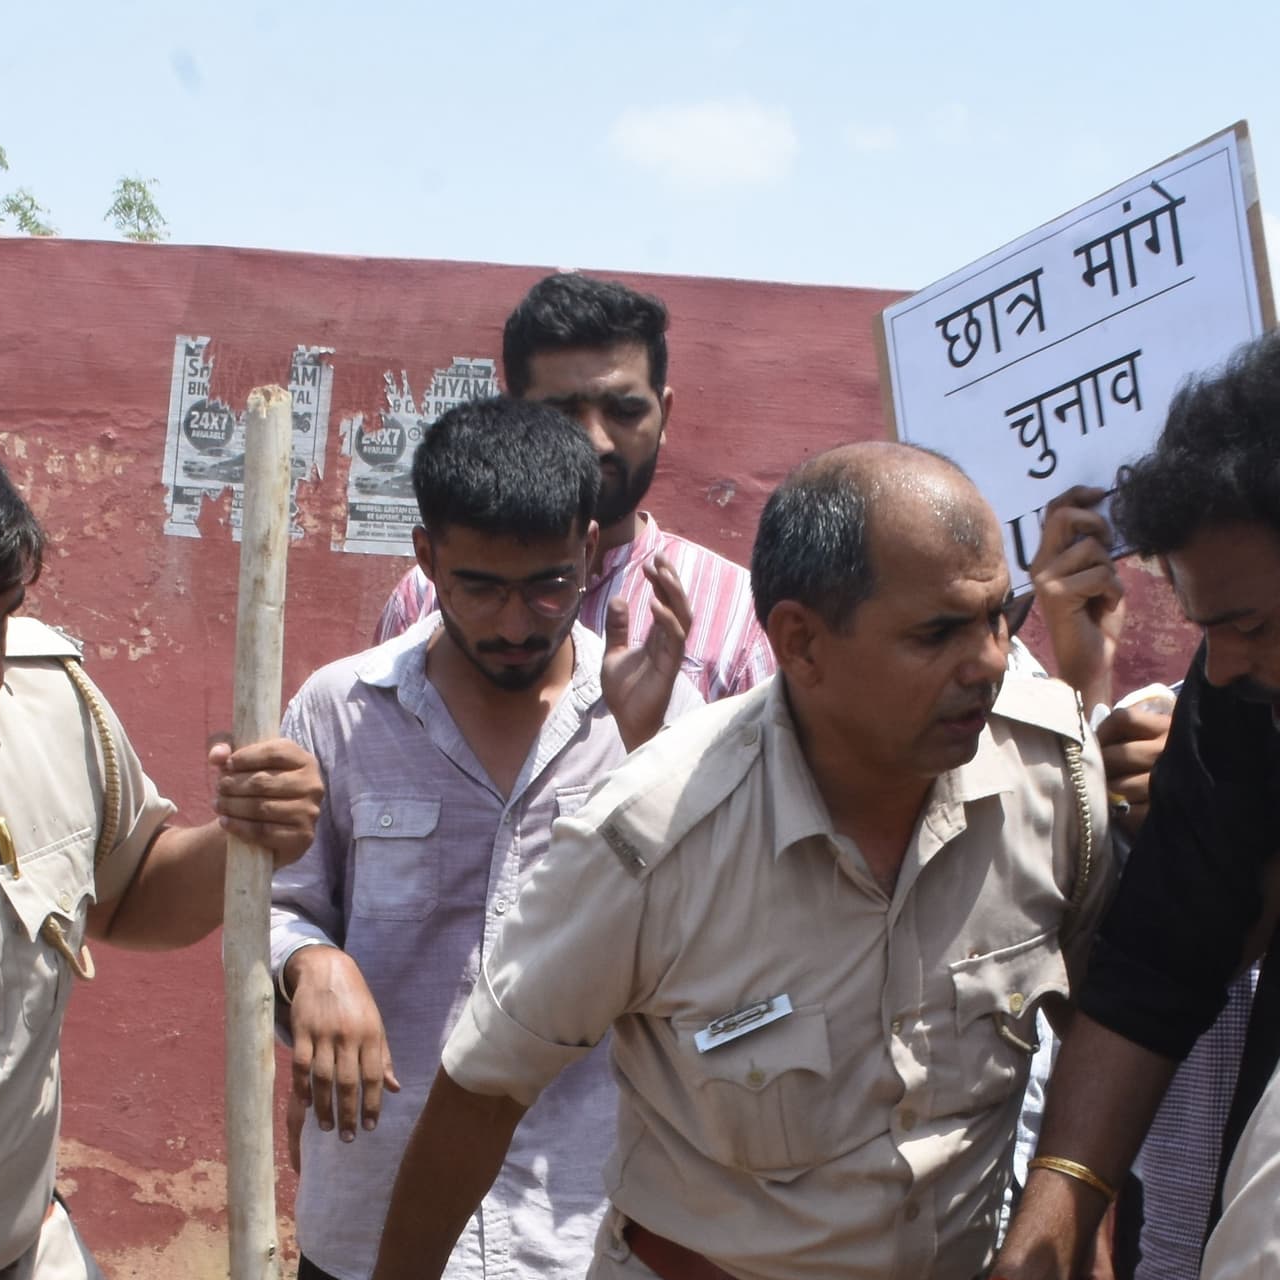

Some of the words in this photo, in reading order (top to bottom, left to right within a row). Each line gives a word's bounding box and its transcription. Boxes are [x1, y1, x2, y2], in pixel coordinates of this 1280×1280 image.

[935, 266, 1047, 369] छात्र
[1073, 180, 1188, 297] मांगे
[187, 381, 210, 397] BIK
[427, 378, 489, 401] HYAM
[405, 399, 431, 415] CR
[1004, 349, 1145, 480] चुनाव
[190, 410, 229, 431] 24X7
